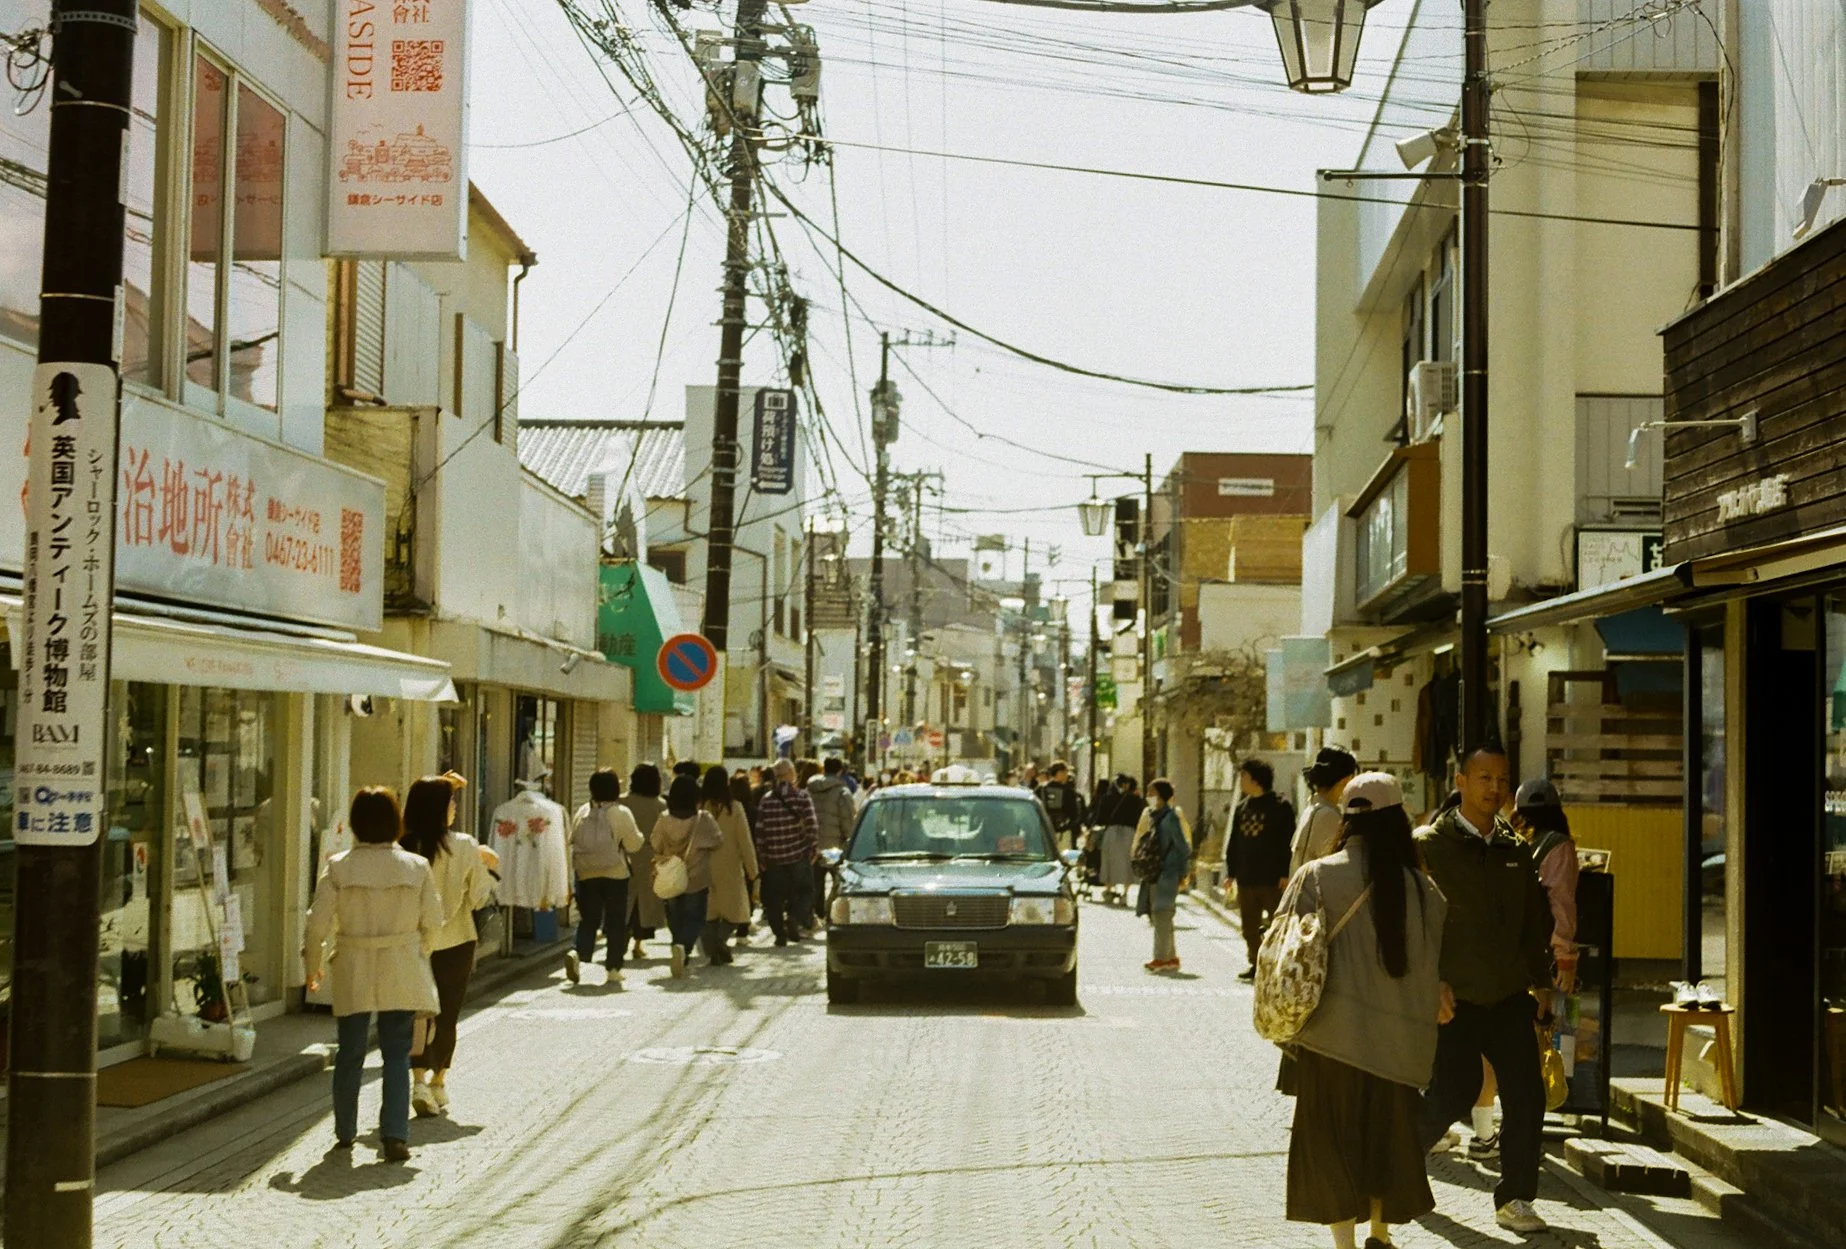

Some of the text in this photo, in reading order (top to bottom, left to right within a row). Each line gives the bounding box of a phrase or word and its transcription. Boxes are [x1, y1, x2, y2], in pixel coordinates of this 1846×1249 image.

[347, 193, 443, 207] 鎌倉シーサイド店
[265, 531, 335, 577] 0467-23-6111
[42, 435, 76, 714] 英国アンティーク博物館
[33, 724, 79, 743] BAM
[18, 811, 93, 834] 車に注意
